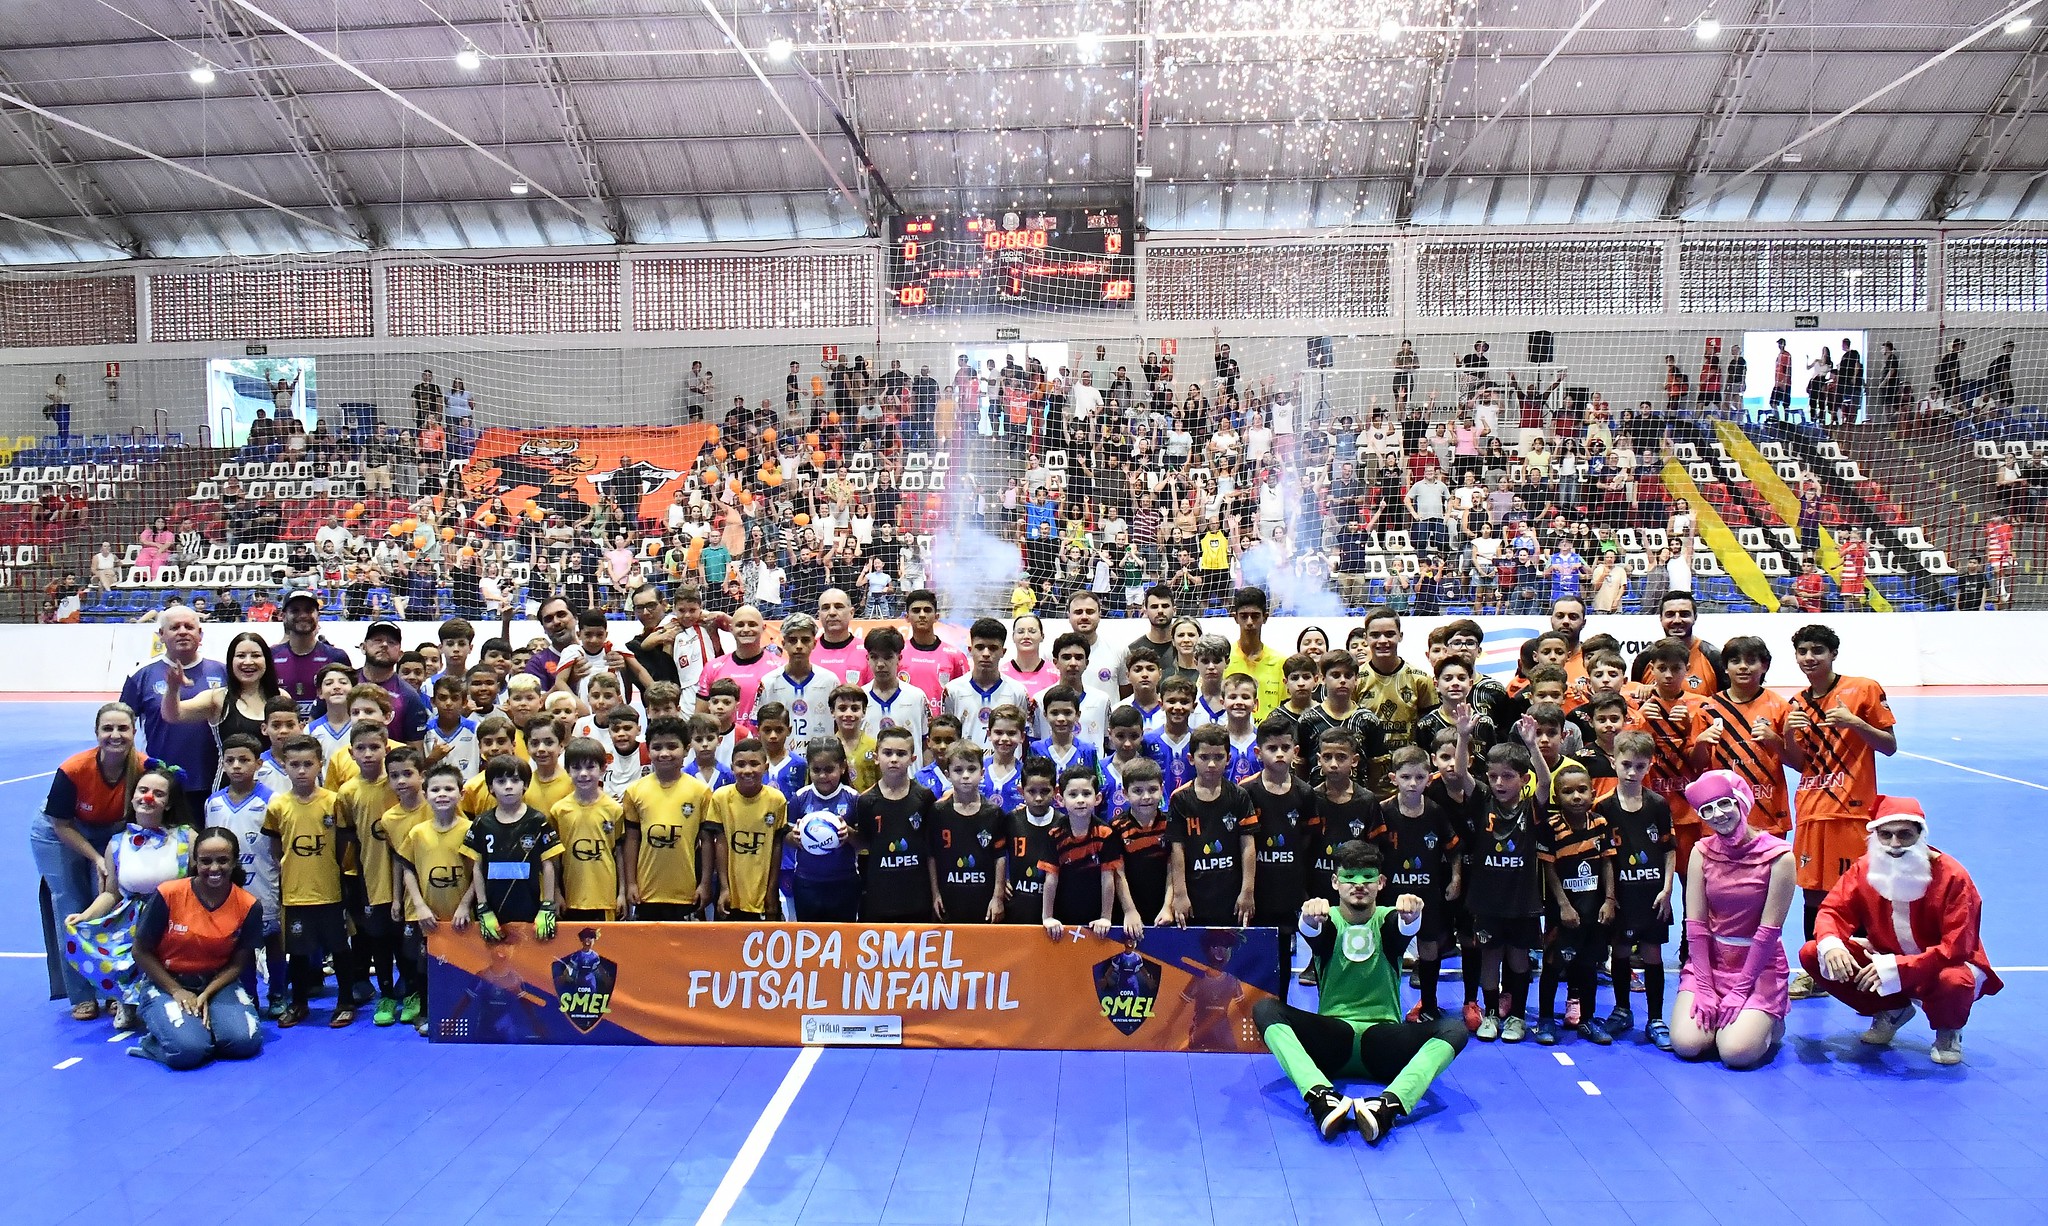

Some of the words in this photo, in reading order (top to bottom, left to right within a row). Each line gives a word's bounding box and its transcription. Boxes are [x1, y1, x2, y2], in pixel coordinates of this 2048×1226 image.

[901, 286, 924, 304] 00
[793, 718, 808, 736] 12
[1186, 816, 1201, 837] 14
[485, 834, 495, 854] 2
[942, 828, 952, 849] 9
[1013, 837, 1027, 857] 13
[880, 854, 919, 868] ALPES
[1193, 856, 1234, 871] ALPES
[1257, 851, 1294, 863] ALPES
[1484, 854, 1525, 868] ALPES
[947, 871, 986, 884] ALPES
[1391, 873, 1431, 885] ALPES
[1620, 867, 1661, 882] ALPES
[742, 929, 843, 970] COPA
[856, 929, 964, 971] SMEL
[687, 970, 829, 1011] FUTSAL
[841, 970, 1020, 1012] INFANTIL
[559, 992, 612, 1014] SMEL
[1100, 995, 1156, 1018] SMEL
[819, 1022, 840, 1033] ITÁLIA
